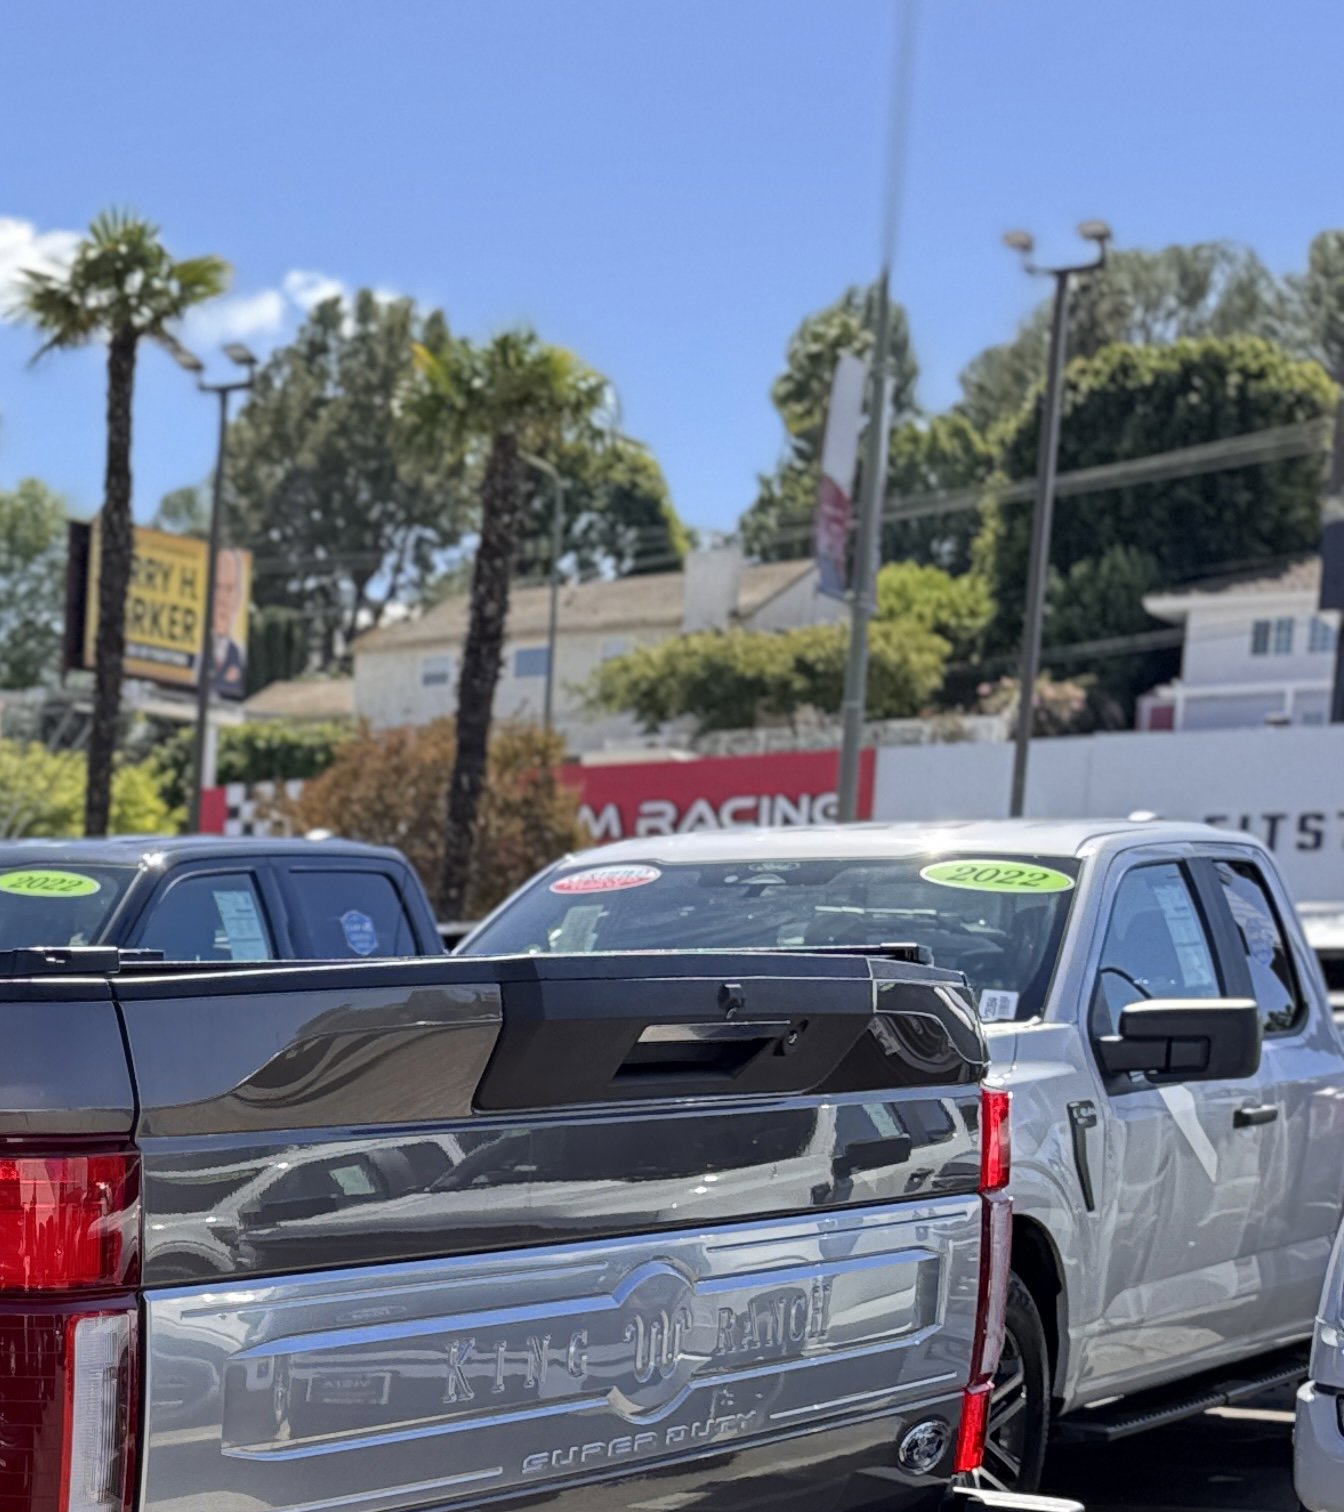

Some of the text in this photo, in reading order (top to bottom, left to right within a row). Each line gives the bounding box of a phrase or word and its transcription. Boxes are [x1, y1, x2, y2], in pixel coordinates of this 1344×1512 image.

[635, 791, 841, 840] RACING
[12, 875, 82, 893] 2022
[946, 866, 1050, 888] 2022
[445, 1277, 832, 1403] KING RANCH
[520, 1411, 759, 1475] SUPER DUTY
